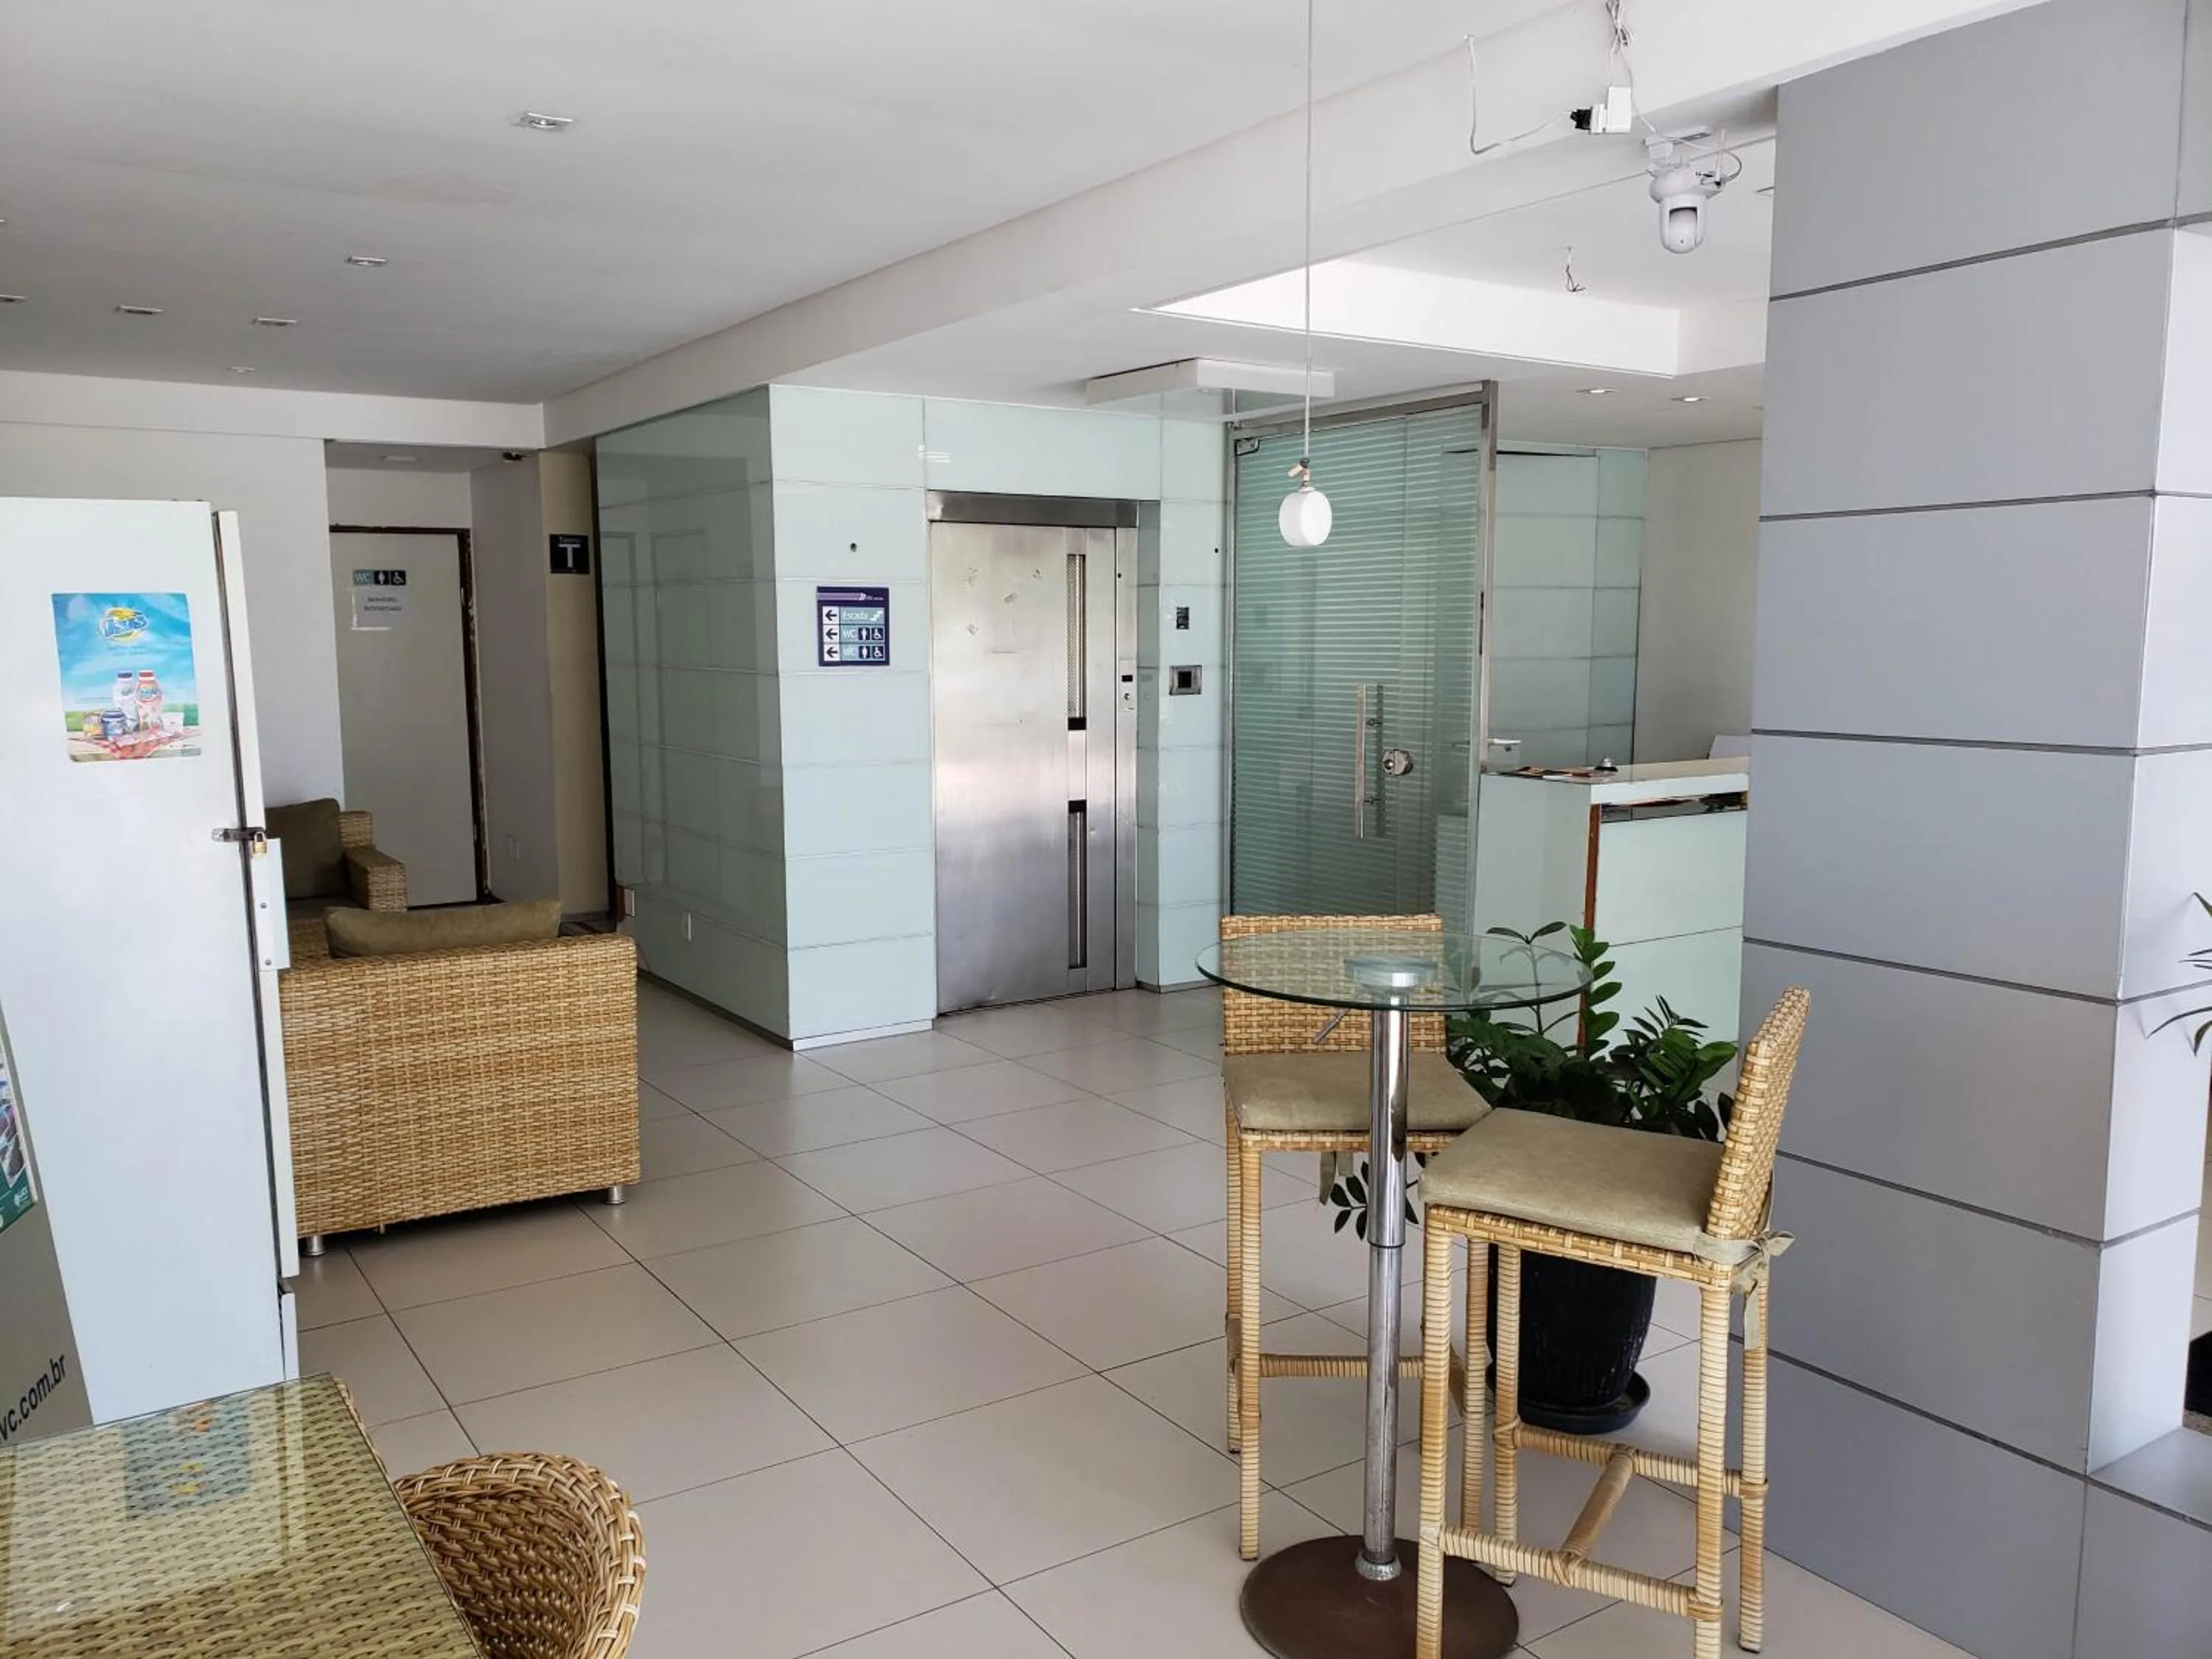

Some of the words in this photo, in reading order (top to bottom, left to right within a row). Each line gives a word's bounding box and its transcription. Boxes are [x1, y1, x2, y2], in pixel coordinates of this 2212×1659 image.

[558, 543, 581, 568] T
[355, 571, 372, 583] WC
[843, 629, 857, 639] WC
[843, 647, 857, 657] WC
